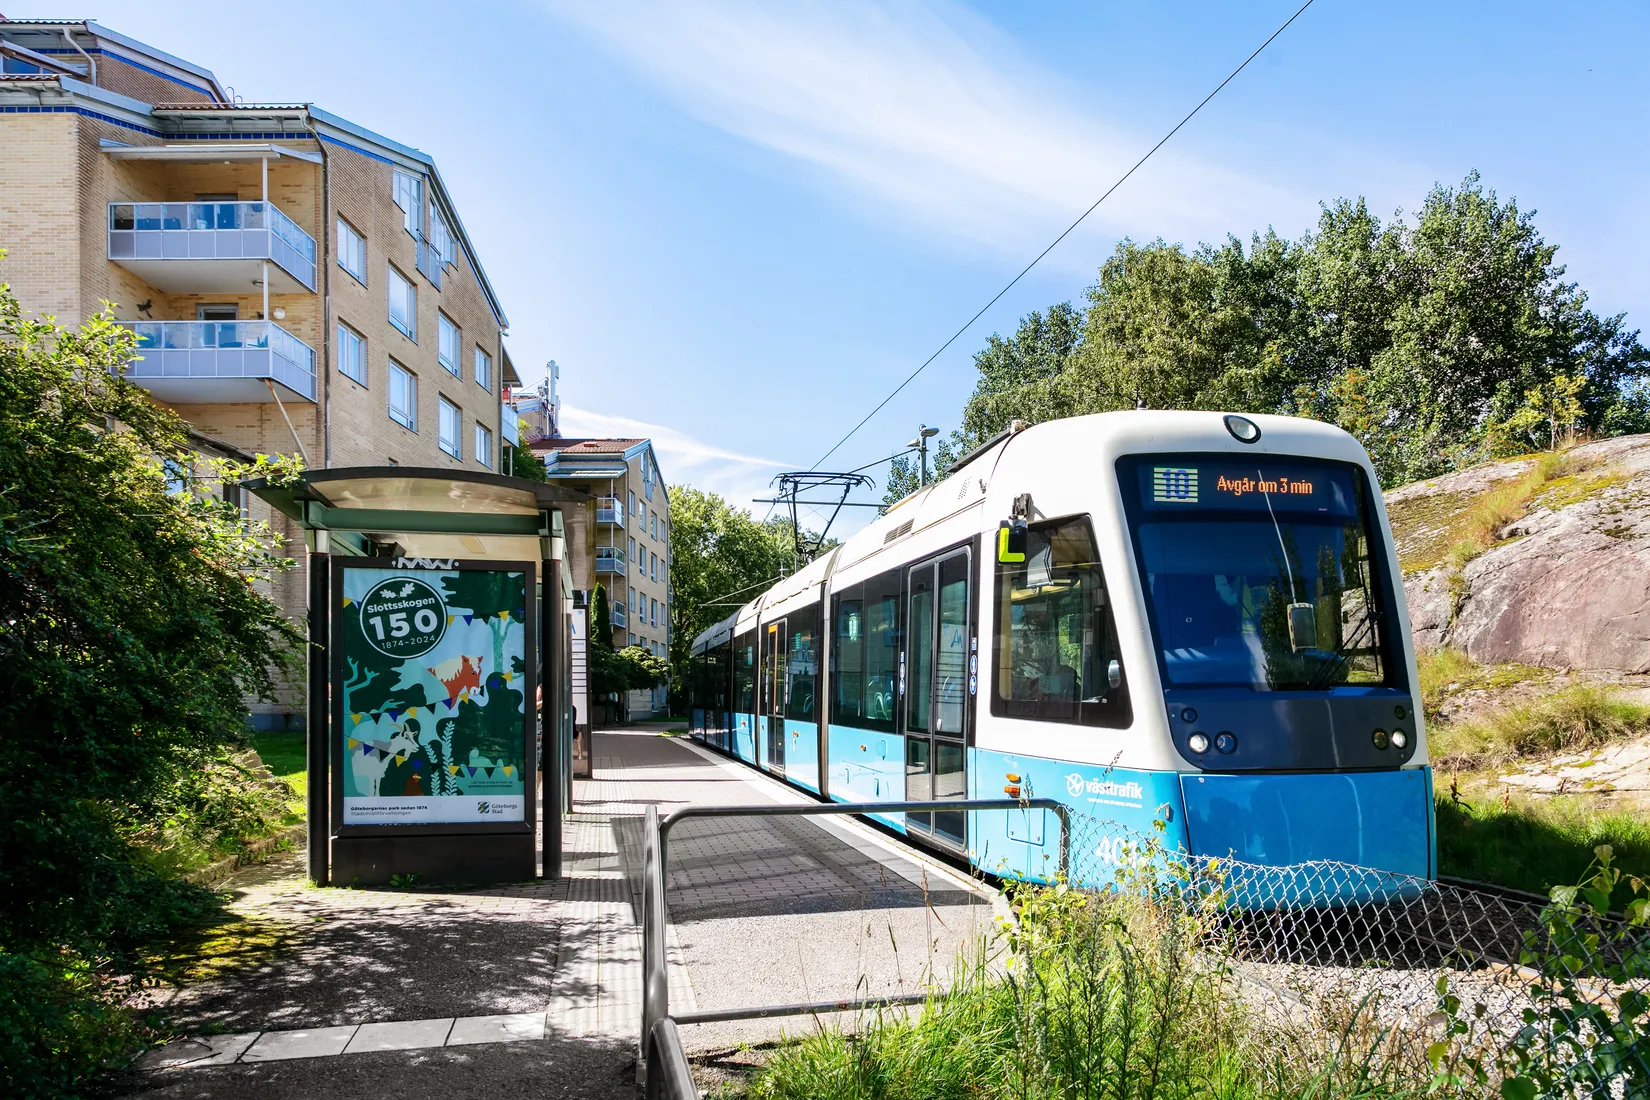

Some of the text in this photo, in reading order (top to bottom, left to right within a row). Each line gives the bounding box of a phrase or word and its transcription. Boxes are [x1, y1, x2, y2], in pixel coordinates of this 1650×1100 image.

[1162, 469, 1189, 499] 10
[1217, 475, 1313, 496] Avgår om 3 min
[367, 597, 435, 613] Slottsskogen
[369, 608, 438, 640] 150
[381, 635, 435, 649] 1874-2024
[1086, 778, 1143, 799] västtrafik
